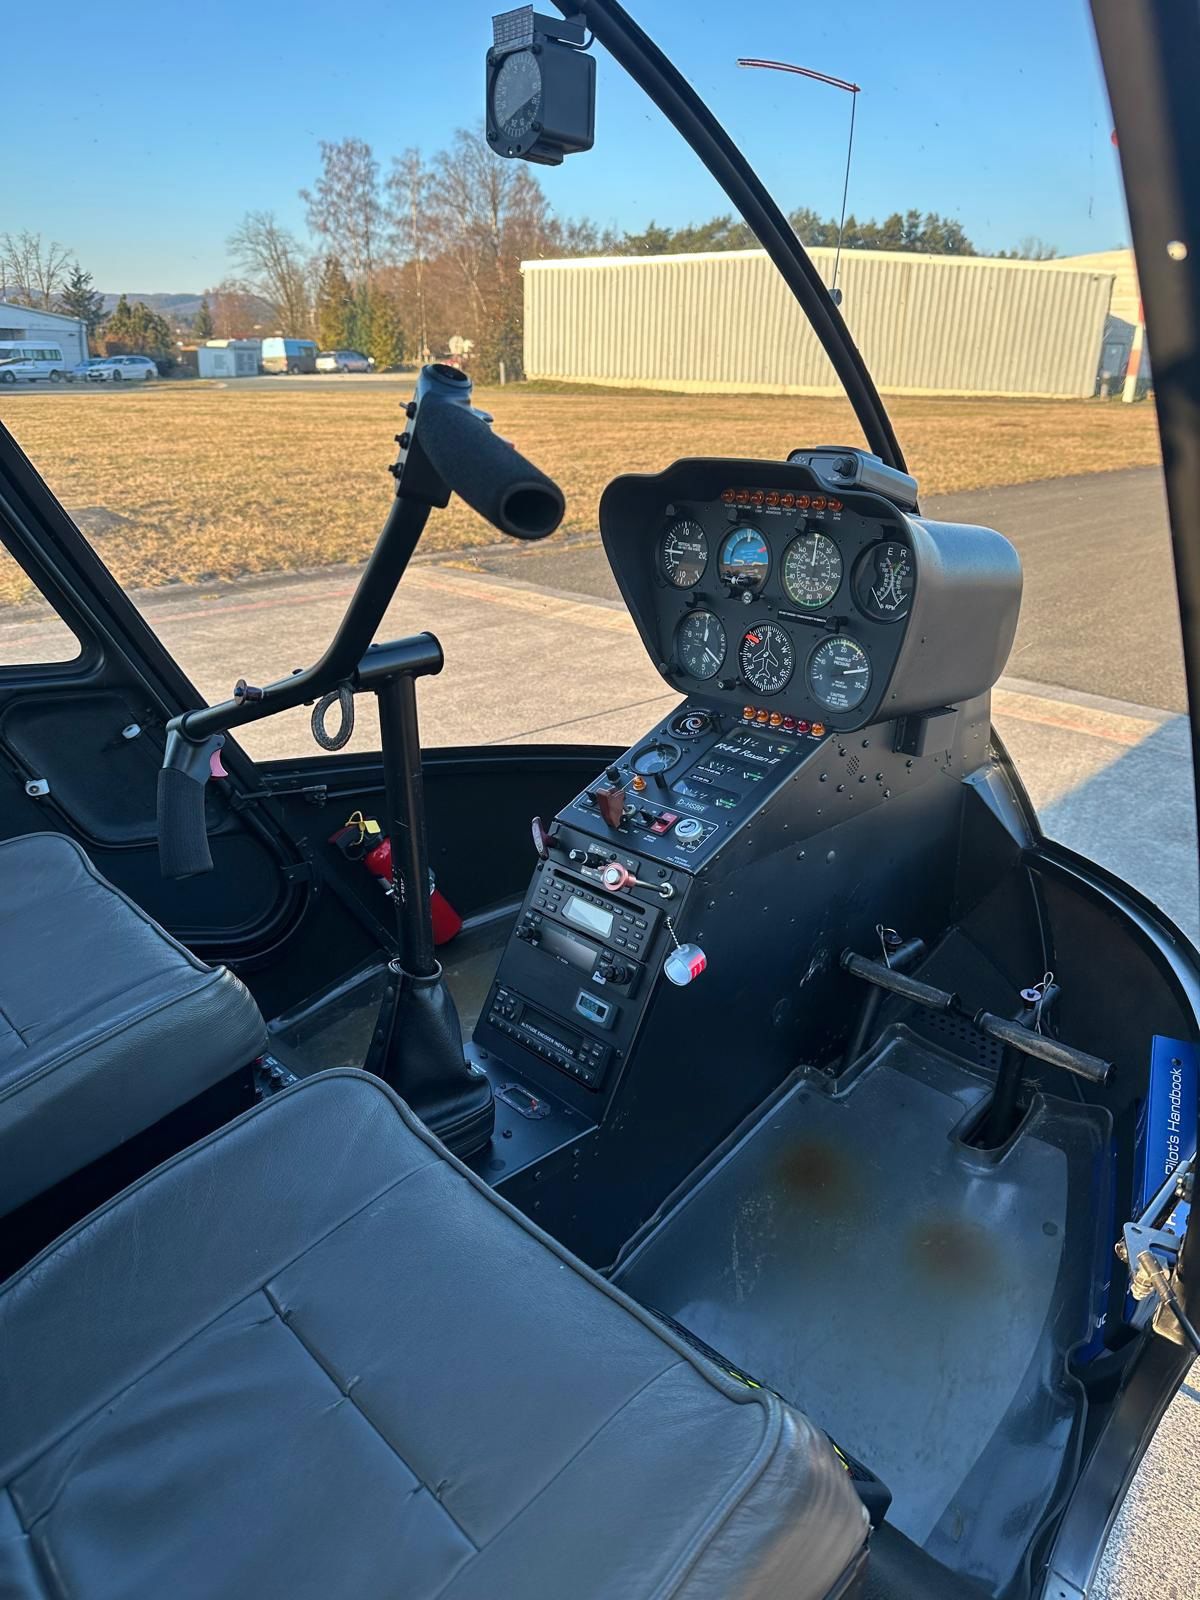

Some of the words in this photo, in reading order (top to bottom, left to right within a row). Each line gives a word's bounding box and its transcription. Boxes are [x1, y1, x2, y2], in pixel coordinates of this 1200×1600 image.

[887, 547, 894, 556] E
[900, 549, 907, 557] R
[714, 742, 741, 753] R44
[520, 1022, 538, 1034] ALTITUDE
[537, 1031, 554, 1043] ENCODER
[554, 1040, 574, 1055] INSTALLED
[1167, 1067, 1182, 1133] Handbook
